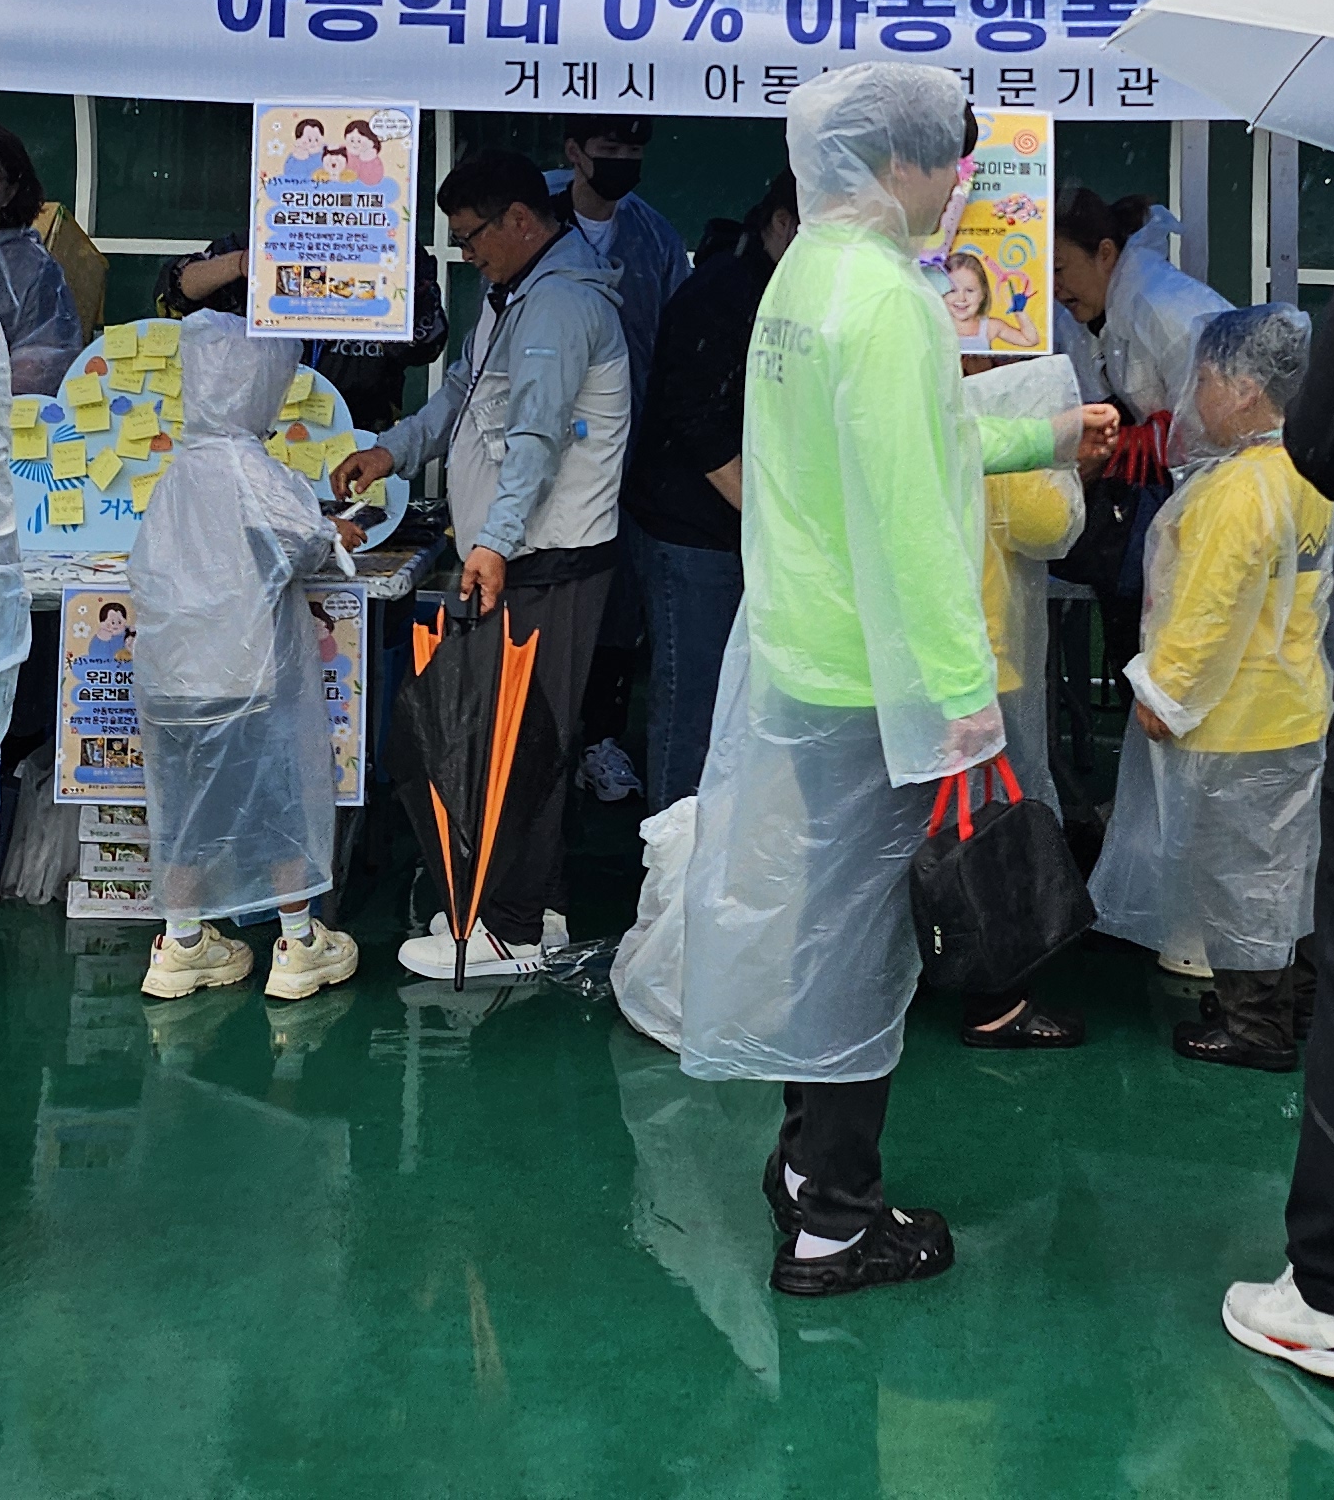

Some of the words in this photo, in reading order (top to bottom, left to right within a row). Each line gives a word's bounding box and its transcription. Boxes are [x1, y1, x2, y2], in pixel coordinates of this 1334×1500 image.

[504, 60, 655, 101] 거제시
[282, 192, 309, 207] 우리
[312, 192, 353, 208] 아이를
[273, 210, 328, 226] 슬로건을
[331, 211, 391, 227] 찾습니다.
[86, 669, 112, 685] 우리
[78, 687, 130, 701] 슬로건을
